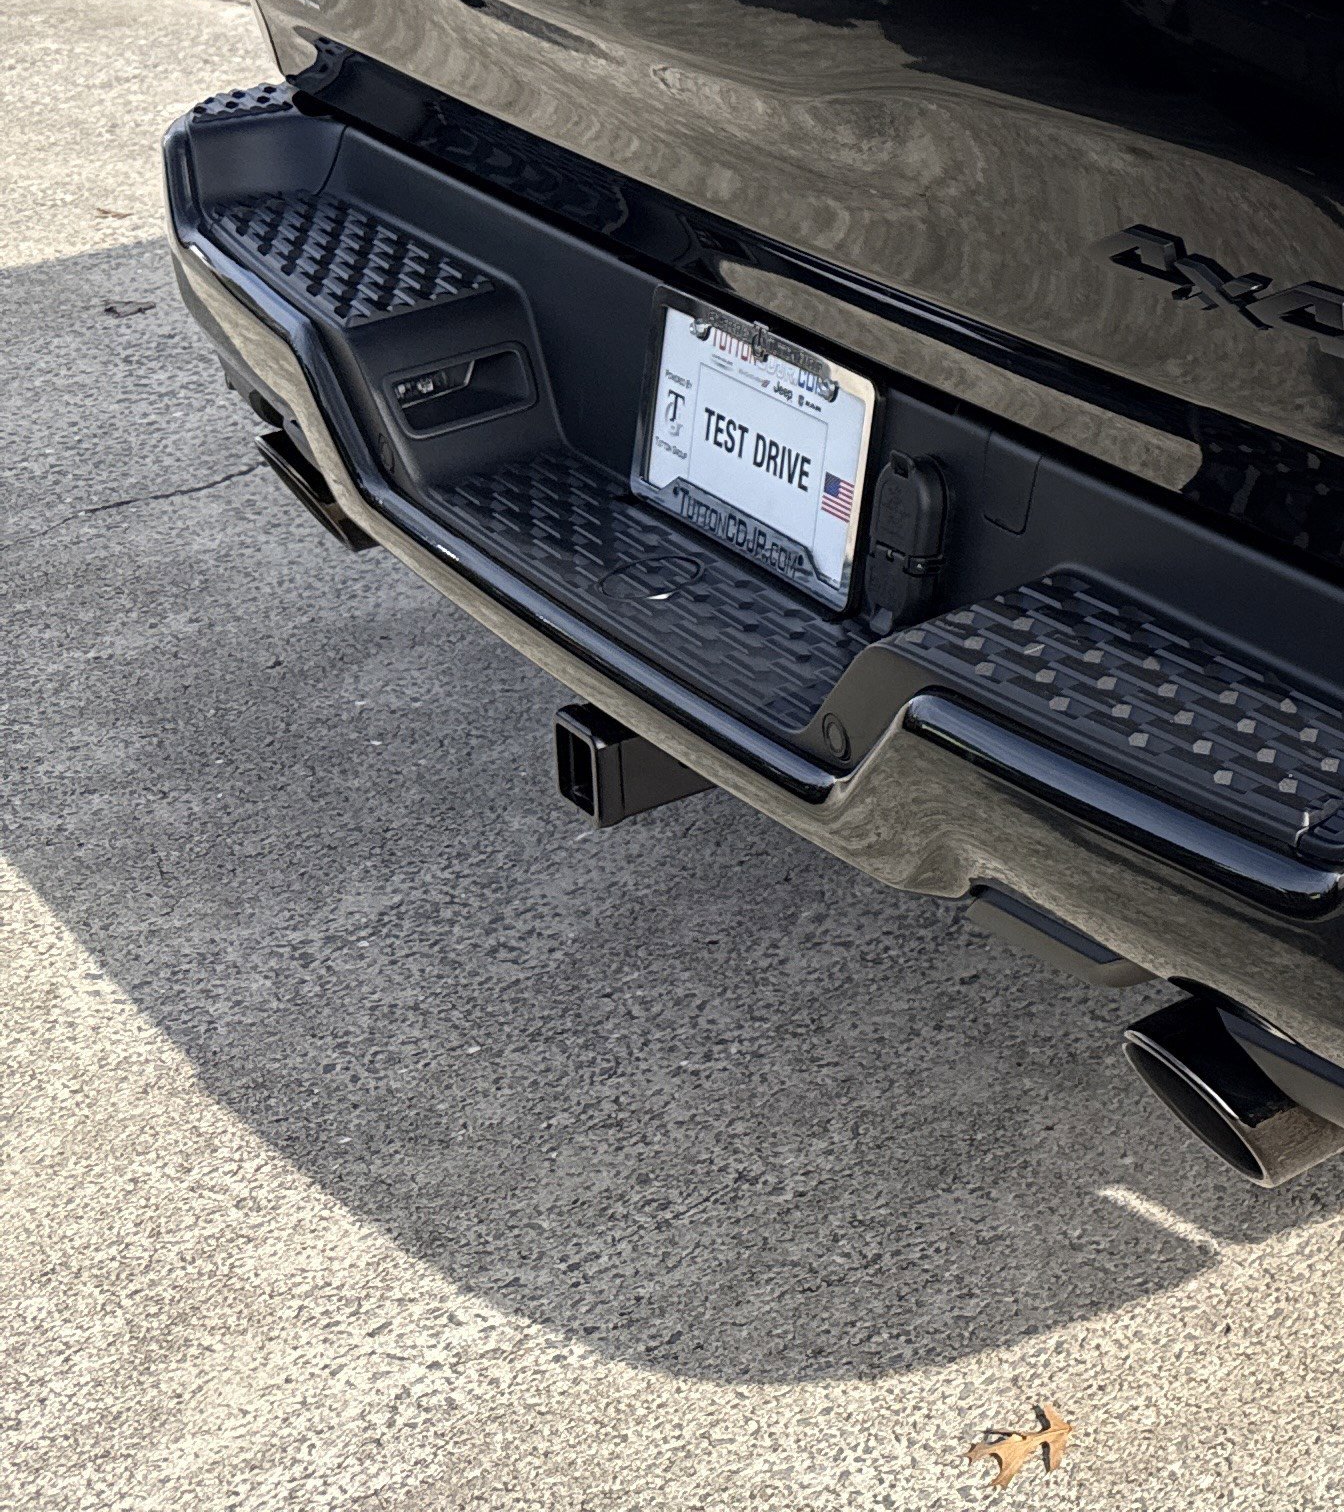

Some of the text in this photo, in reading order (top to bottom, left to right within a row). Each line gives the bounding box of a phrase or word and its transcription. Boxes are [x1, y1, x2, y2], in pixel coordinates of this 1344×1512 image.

[773, 381, 794, 402] Jeep
[704, 406, 812, 494] TEST DRIVE
